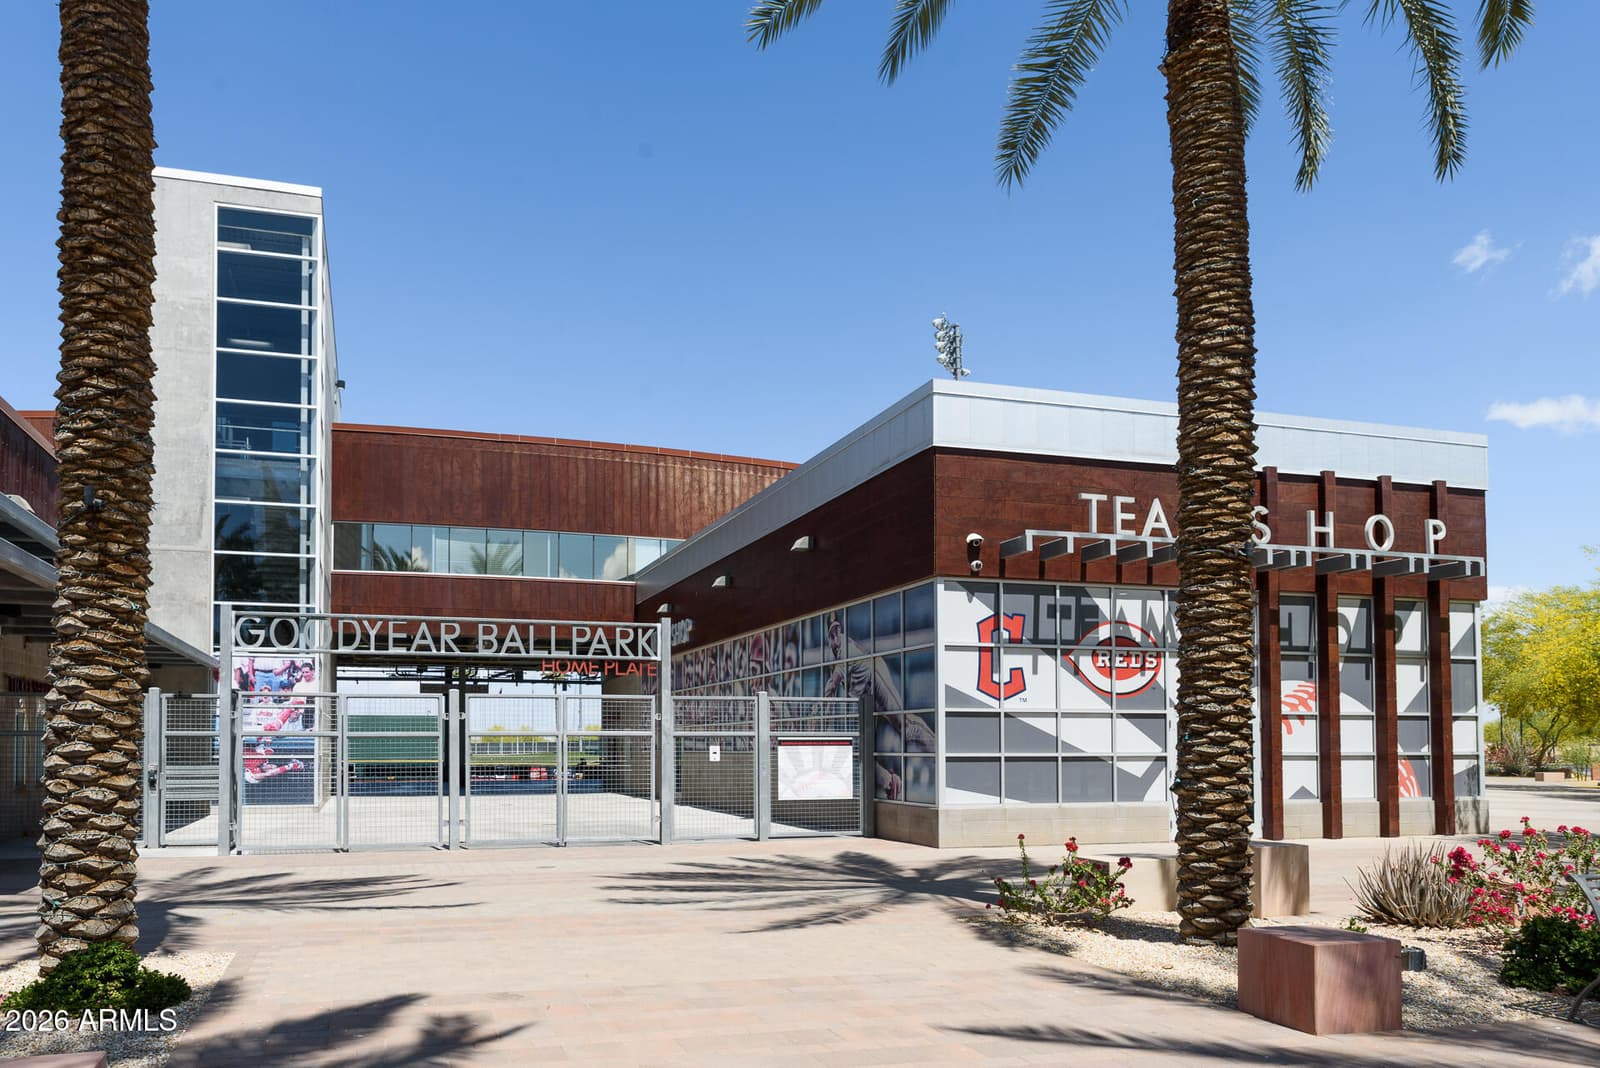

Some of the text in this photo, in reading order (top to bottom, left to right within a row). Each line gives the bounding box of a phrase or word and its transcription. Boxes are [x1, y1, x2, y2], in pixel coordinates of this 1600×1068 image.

[1078, 493, 1447, 554] TEA SHOP
[235, 616, 461, 653] GOODYEAR
[477, 623, 658, 657] BALLPARK
[541, 658, 657, 676] HOME PLATE
[1095, 649, 1159, 669] REDS
